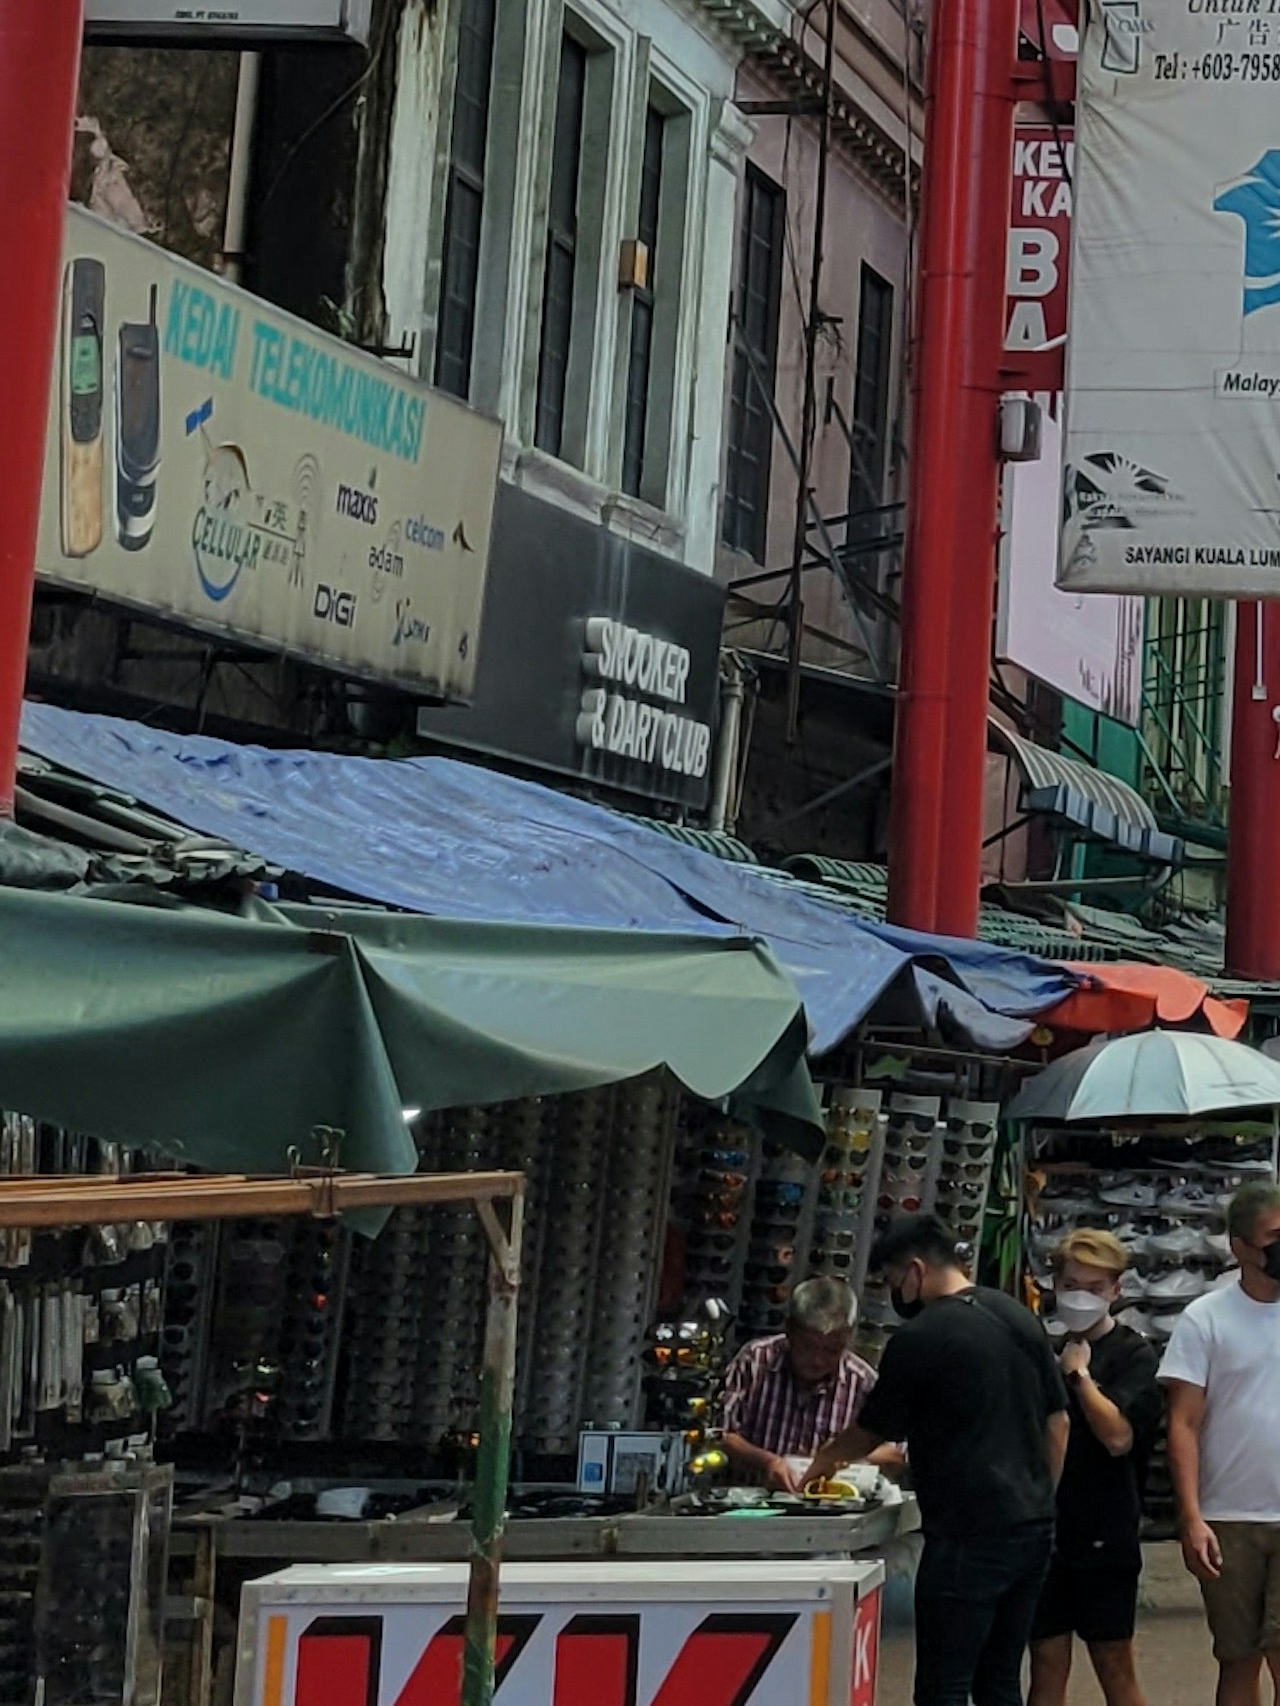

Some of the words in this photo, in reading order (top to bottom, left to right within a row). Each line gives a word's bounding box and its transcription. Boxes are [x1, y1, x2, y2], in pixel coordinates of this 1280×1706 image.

[164, 278, 241, 381] KEDAI
[251, 319, 428, 466] TELEKOMUNIKASI
[336, 483, 378, 526] maxis
[192, 504, 263, 571] CELLULAR
[405, 513, 446, 552] celcom
[1124, 546, 1191, 564] SAYANGI
[1195, 547, 1246, 566] KUALA
[368, 543, 405, 579] adam
[598, 620, 691, 705] SNOOKER
[608, 694, 664, 764] DART
[661, 713, 711, 779] CLUB
